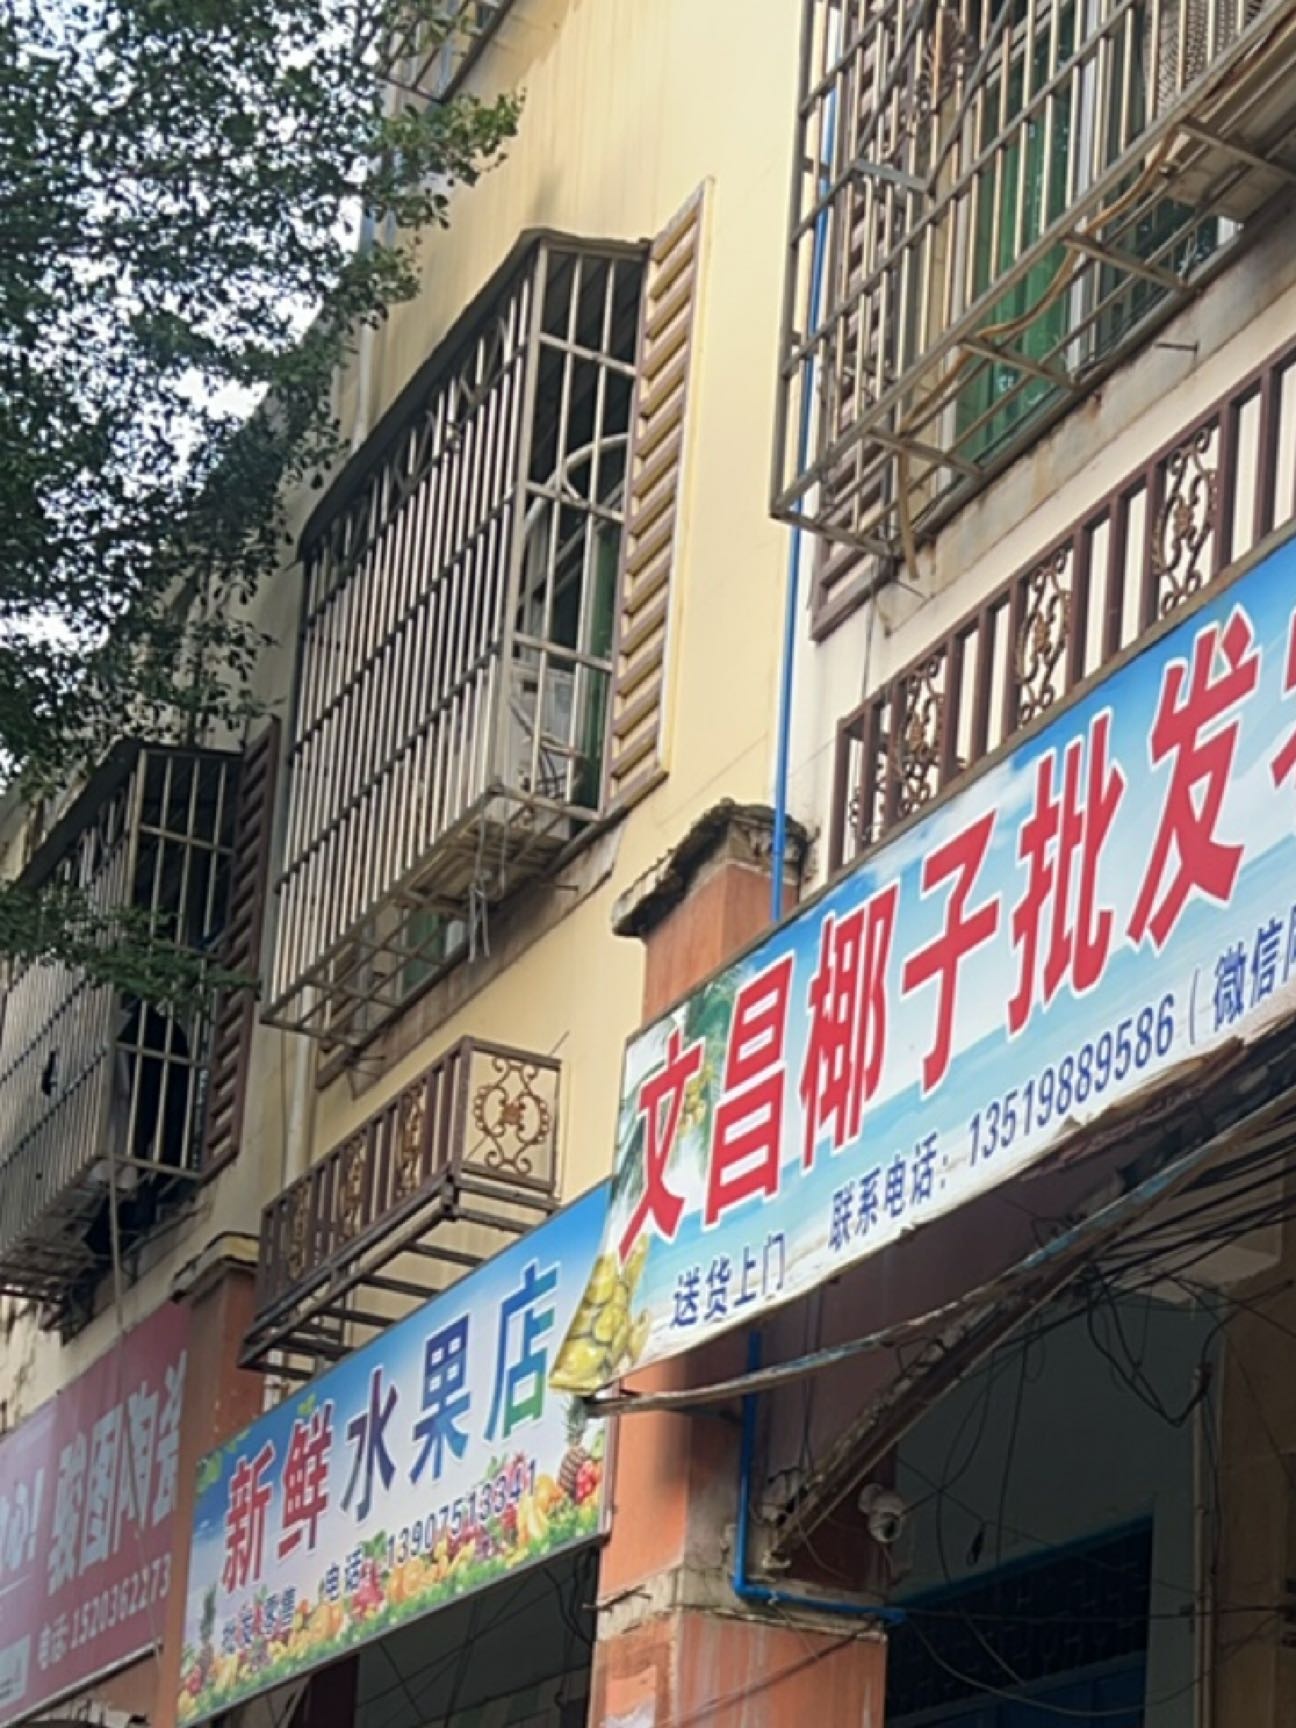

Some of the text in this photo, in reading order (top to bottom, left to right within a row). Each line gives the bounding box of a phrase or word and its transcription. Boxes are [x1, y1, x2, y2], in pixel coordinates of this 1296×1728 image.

[670, 1232, 785, 1328] 送货上门
[222, 1258, 561, 1593] 新鲜水果店
